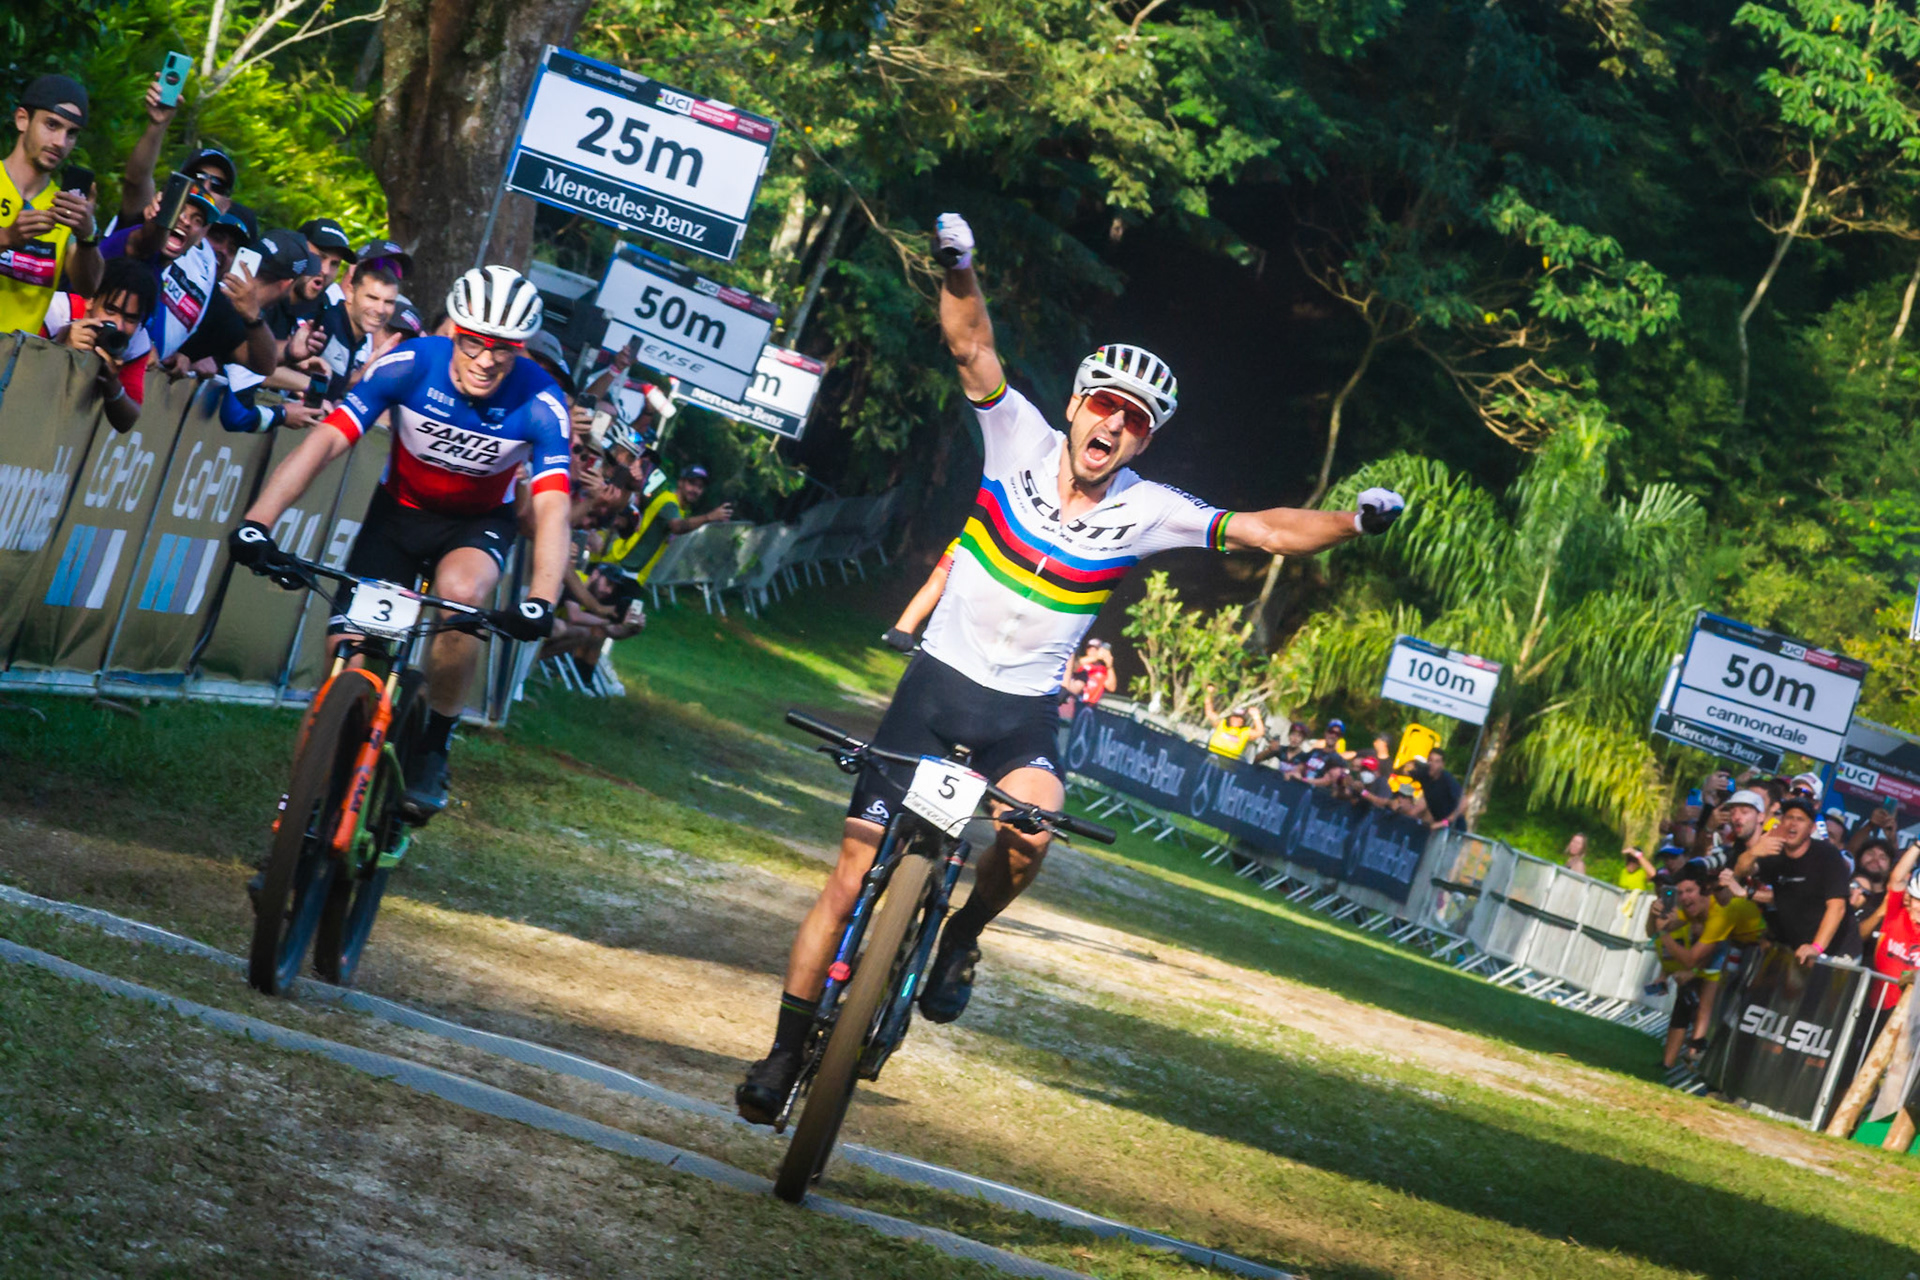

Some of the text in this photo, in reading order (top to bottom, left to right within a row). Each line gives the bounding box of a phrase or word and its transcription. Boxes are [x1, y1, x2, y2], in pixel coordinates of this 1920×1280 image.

[664, 93, 690, 111] UCI
[576, 107, 704, 188] 25m
[540, 167, 707, 242] Mercedes-Benz
[634, 286, 726, 349] 50m
[644, 345, 705, 373] ENSE
[415, 421, 502, 454] SANTA
[428, 440, 500, 466] CRUZ
[84, 429, 155, 513] GoPro
[172, 440, 243, 523] GoPro
[1019, 470, 1137, 540] SCOTT
[372, 599, 392, 622] 3
[1784, 645, 1804, 658] UCI
[1407, 657, 1475, 695] 100m
[1721, 654, 1816, 712] 50m
[1670, 720, 1763, 763] Mercedes-Benz
[1706, 704, 1808, 745] cannondale
[938, 775, 960, 800] 5
[1845, 767, 1875, 786] UCI
